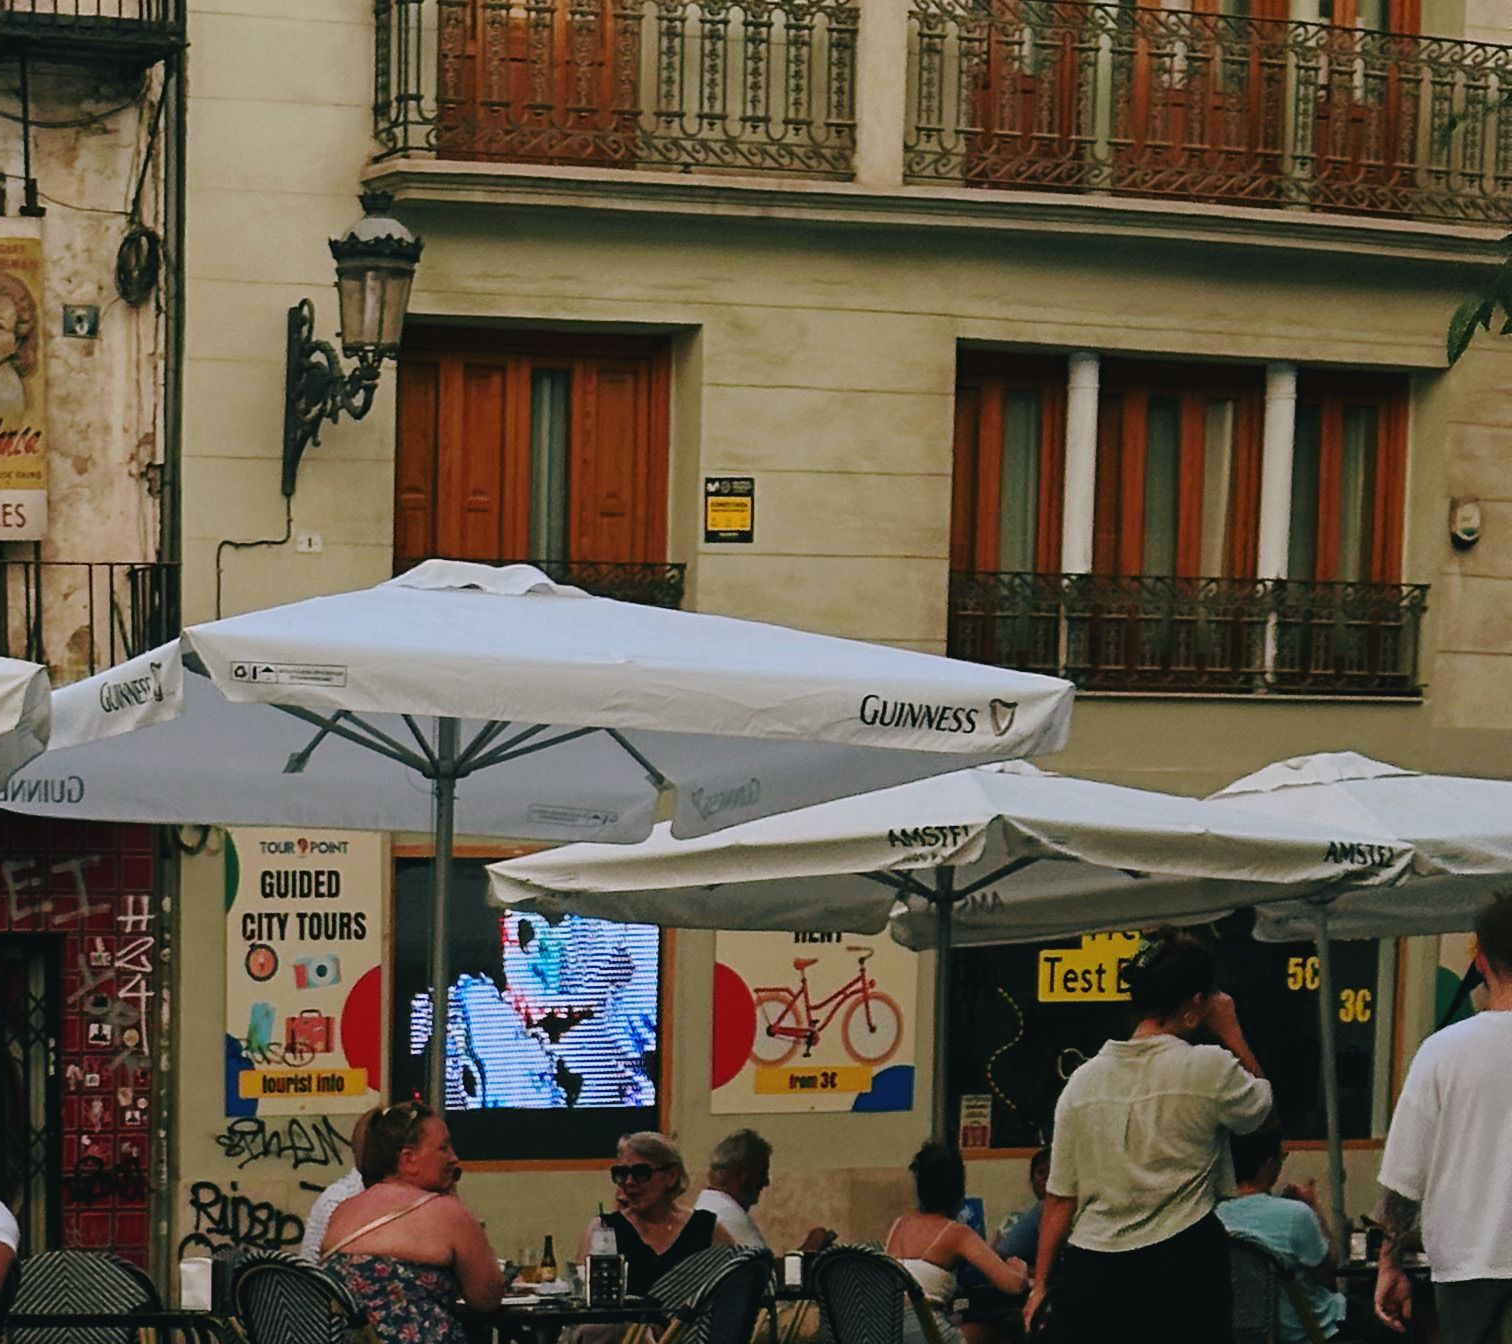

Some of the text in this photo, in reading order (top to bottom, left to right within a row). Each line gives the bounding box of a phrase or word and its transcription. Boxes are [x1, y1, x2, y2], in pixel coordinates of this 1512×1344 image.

[859, 693, 980, 734] GUINNESS
[259, 840, 349, 854] TOUR POINT
[260, 869, 341, 899] GUIDED
[241, 911, 367, 942] CITY TOURS
[1043, 956, 1107, 994] Test
[261, 1073, 345, 1095] tourist info
[788, 1072, 818, 1089] from
